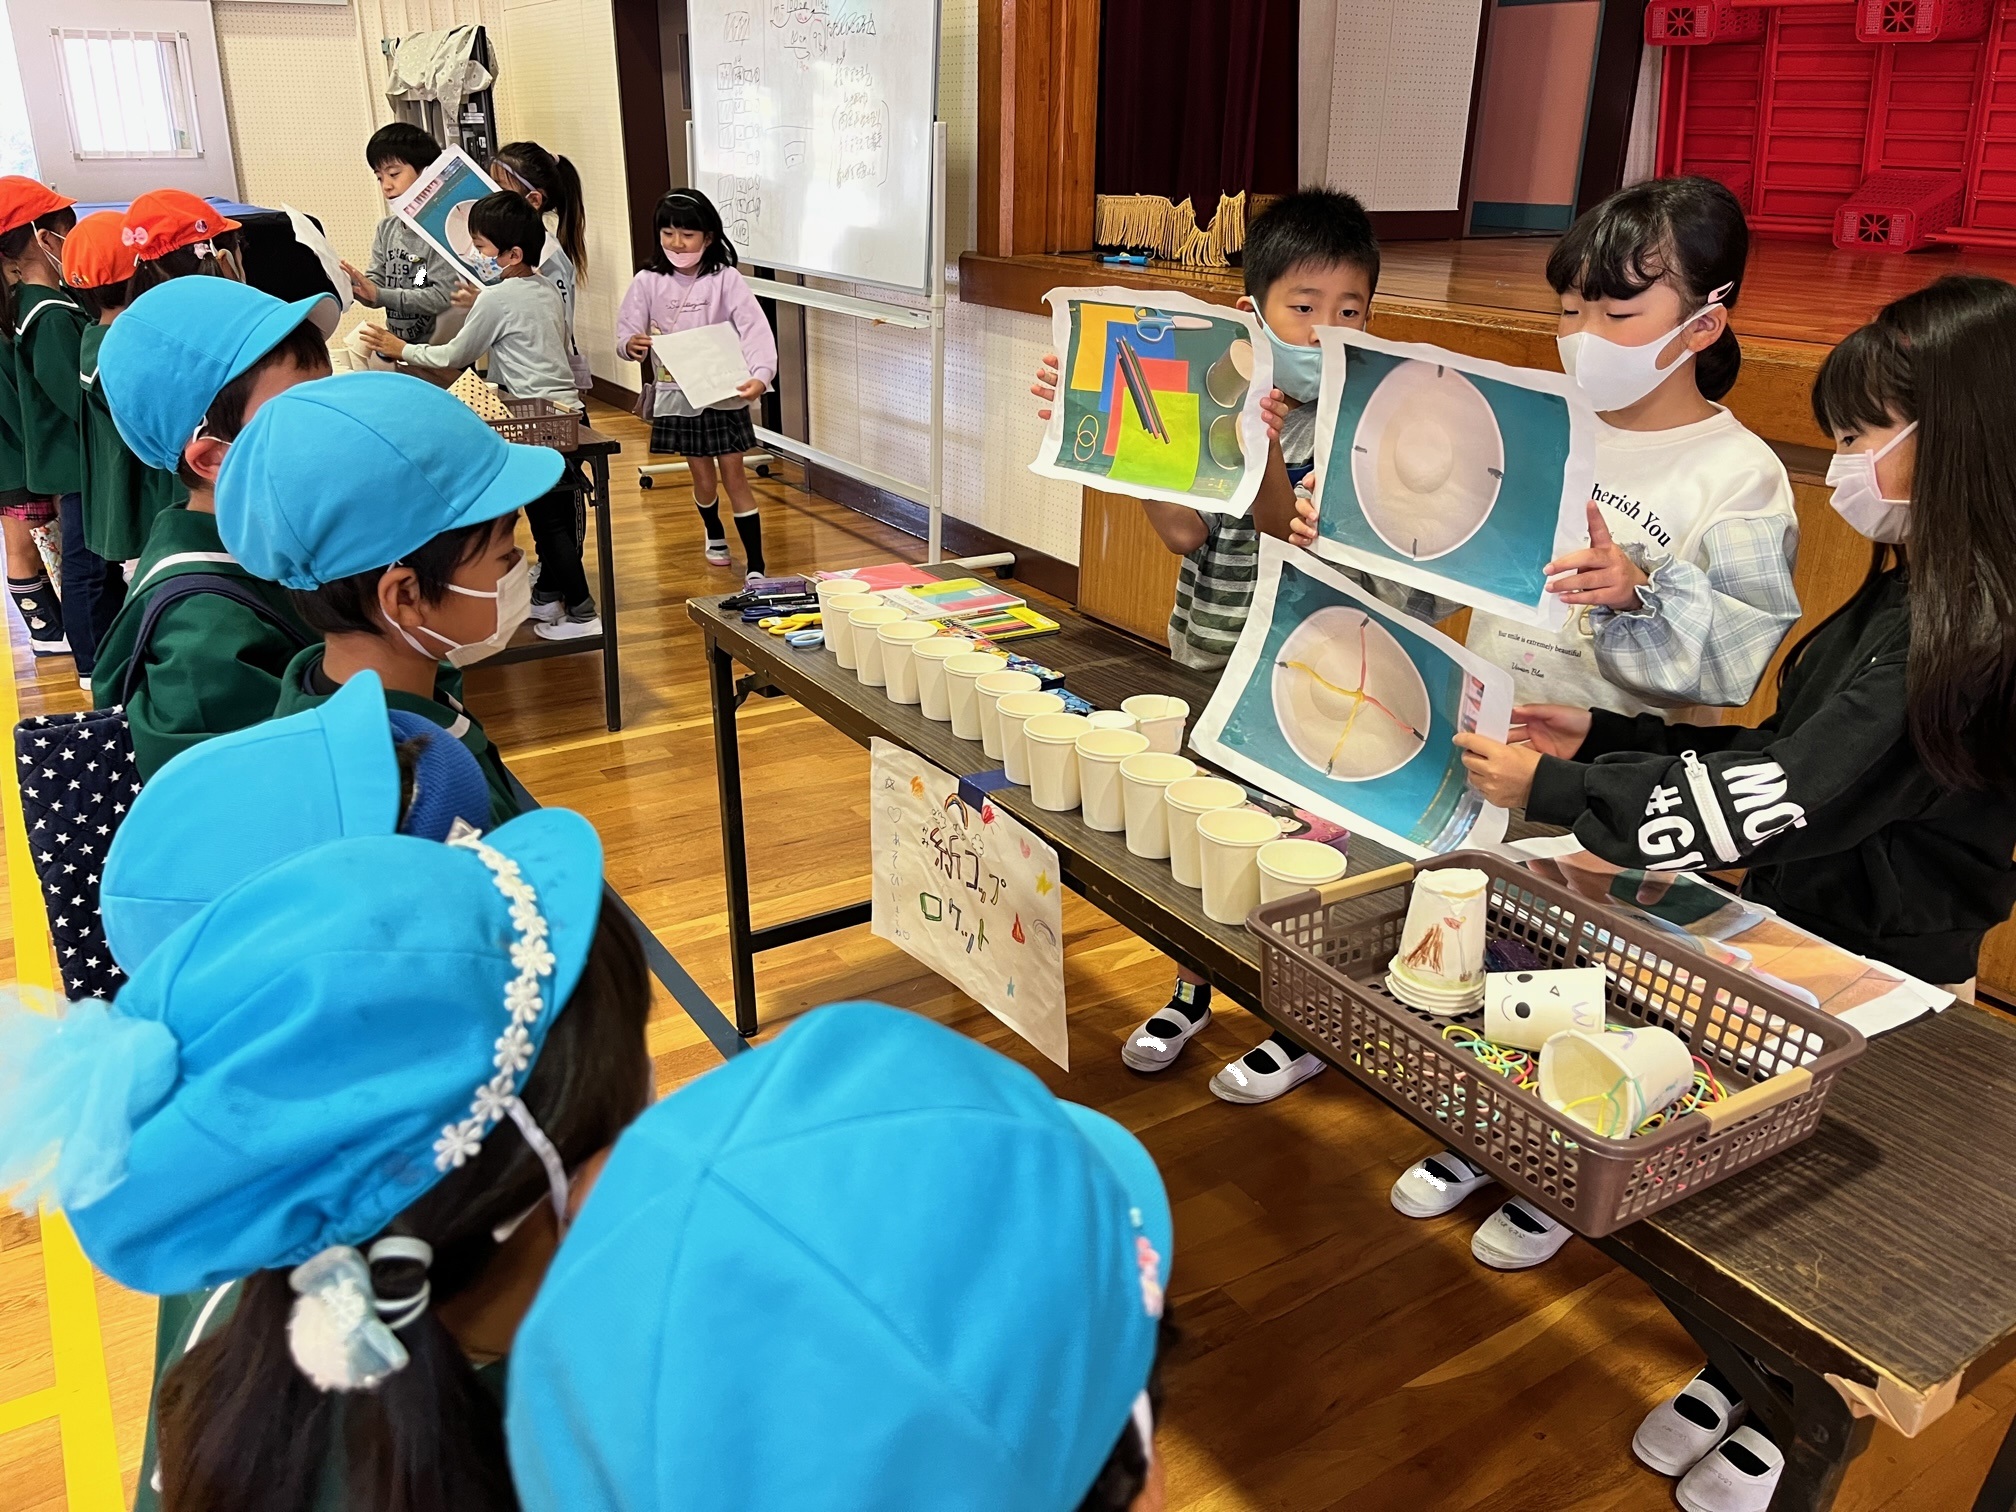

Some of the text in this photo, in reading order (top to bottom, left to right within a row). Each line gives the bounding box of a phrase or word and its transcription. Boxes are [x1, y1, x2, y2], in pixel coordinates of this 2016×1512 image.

[1591, 483, 1671, 547] herish You
[1526, 638, 1554, 652] extremely
[1554, 644, 1582, 658] beautiful
[929, 827, 1007, 906] 紙コップ
[919, 891, 990, 954] ロケット
